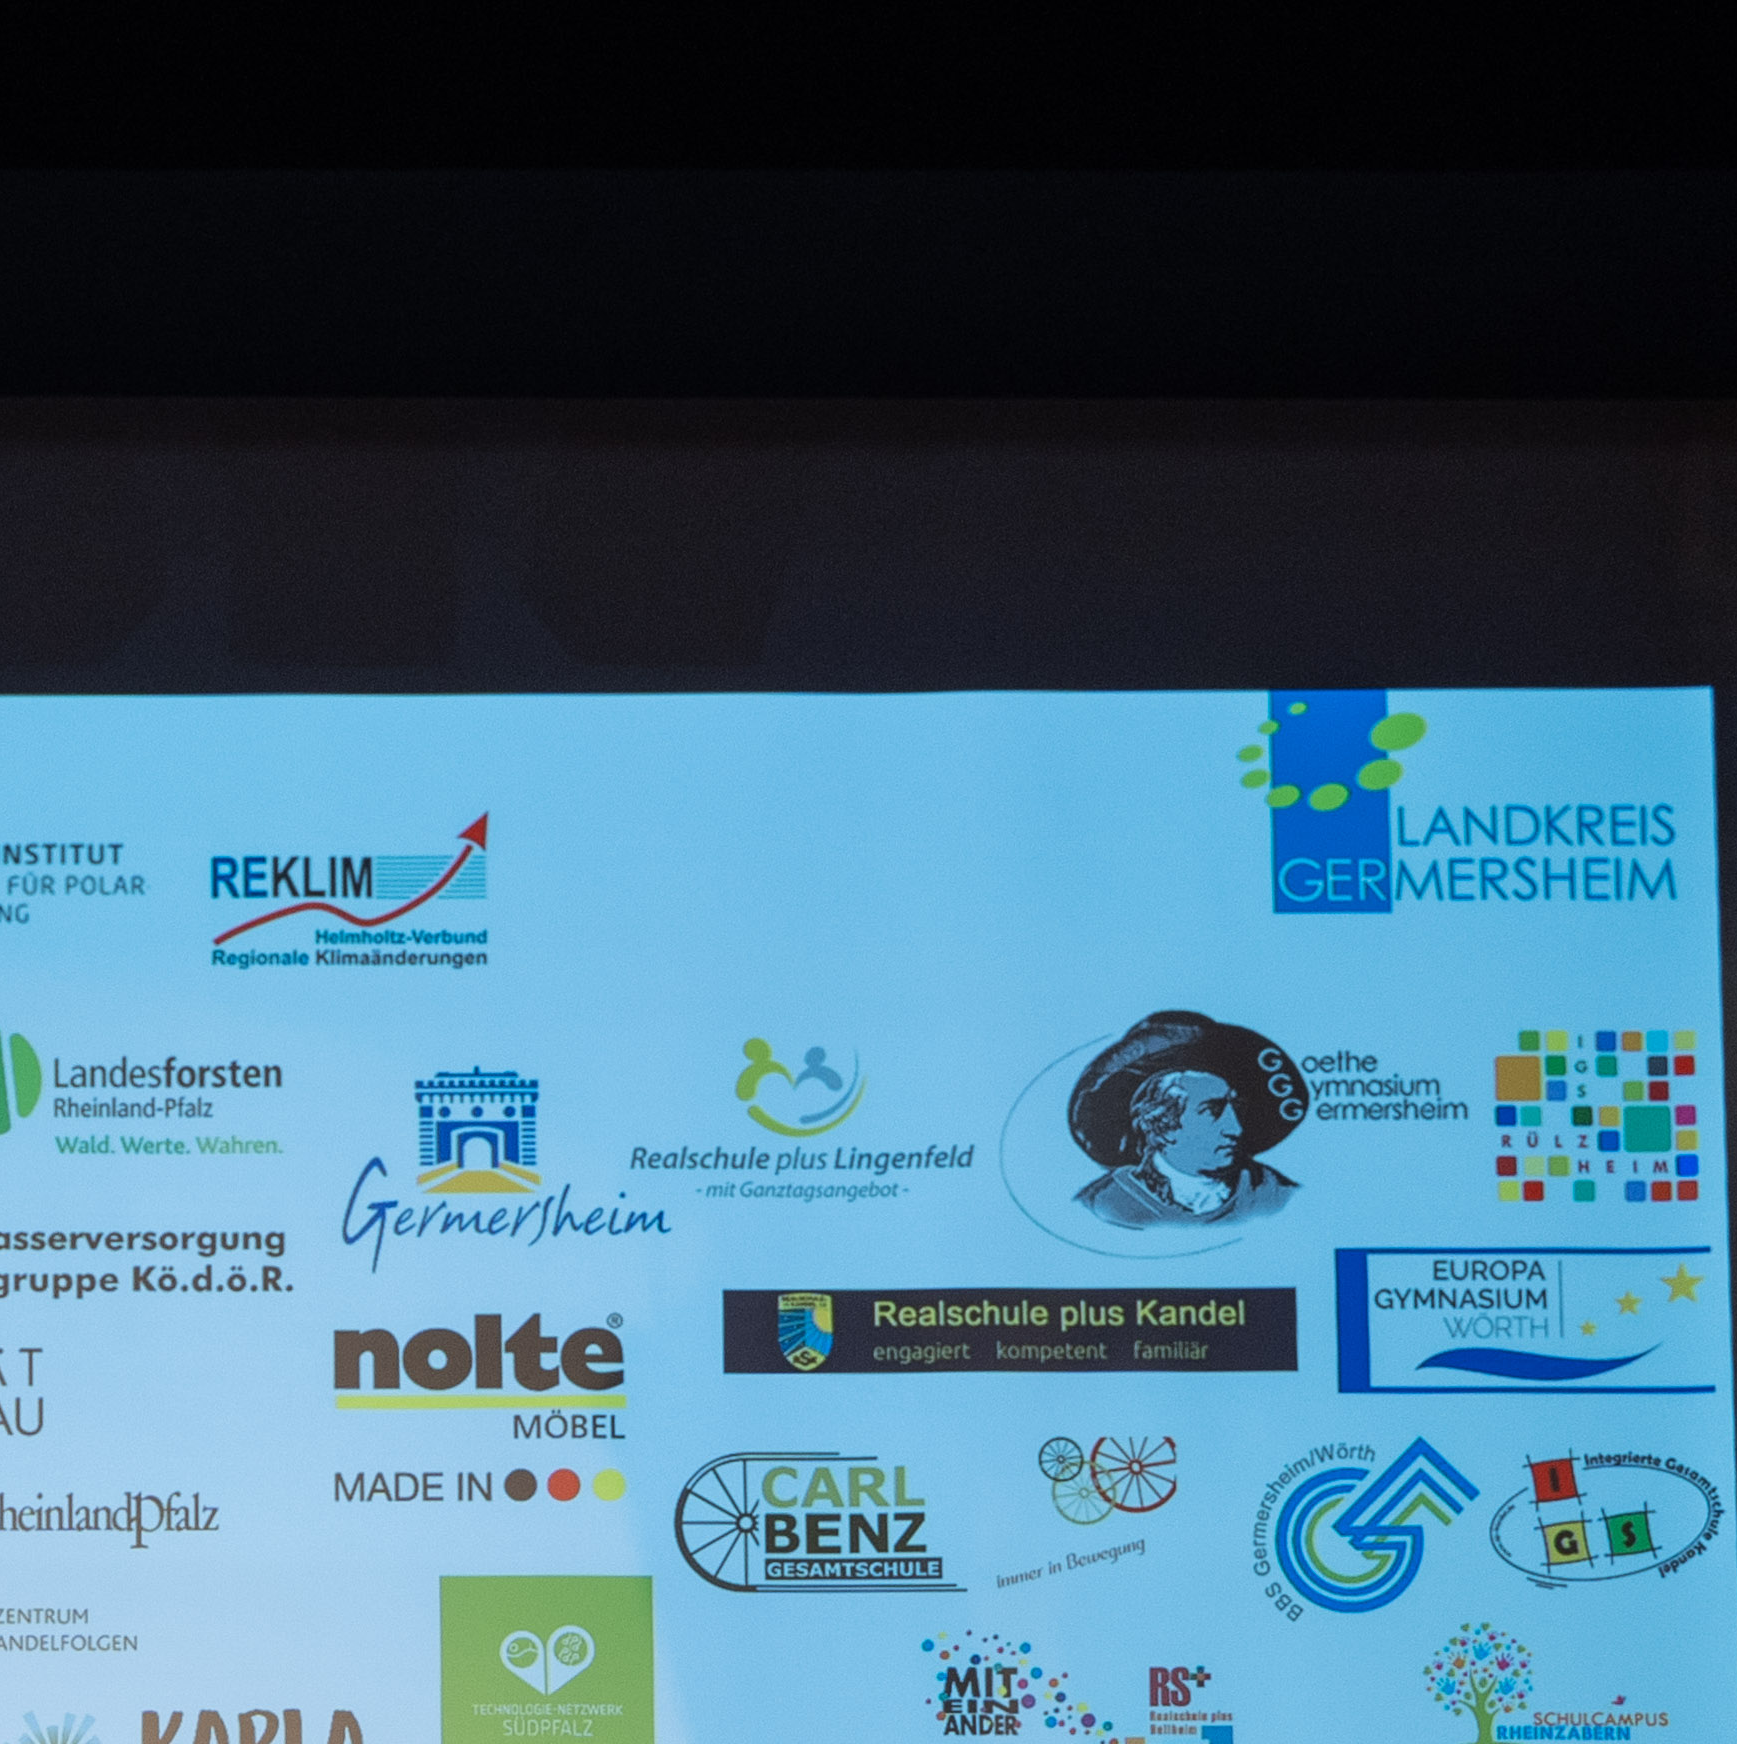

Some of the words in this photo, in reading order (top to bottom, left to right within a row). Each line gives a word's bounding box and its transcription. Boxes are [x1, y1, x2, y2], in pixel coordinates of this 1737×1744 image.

[1396, 803, 1677, 848] LANDKREIS
[7, 872, 58, 897] FÜR
[211, 855, 374, 899] REKLIM
[1277, 857, 1678, 902] GERMERSHEIM
[315, 928, 489, 947] Helmholtz-Verbund
[211, 949, 310, 969] Regionale
[315, 949, 489, 969] Klimaänderungen
[54, 1056, 283, 1090] Landesforsten
[1257, 1047, 1378, 1073] Goethe
[53, 1097, 214, 1122] Rheinland-Pfalz
[1279, 1097, 1469, 1122] Germersheim
[55, 1133, 117, 1156] Wald.
[121, 1133, 192, 1156] Werte.
[197, 1133, 284, 1156] Wahren.
[630, 1145, 771, 1172] Realschule
[775, 1146, 828, 1176] plus
[833, 1143, 975, 1176] Lingenfeld
[341, 1155, 672, 1274] Germersheim
[131, 1264, 295, 1295] Kö.d.ö.R.
[1433, 1260, 1546, 1281] EUROPA
[1374, 1288, 1548, 1310] GYMNASIUM
[873, 1299, 1048, 1328] Realschule
[1060, 1299, 1125, 1332] plus
[1136, 1297, 1247, 1328] Kandel
[1443, 1312, 1549, 1339] WÖRTH
[873, 1341, 972, 1364] engagiert
[996, 1340, 1109, 1365] kompetent
[1132, 1338, 1210, 1361] familiär
[512, 1412, 626, 1440] MÖBEL
[1583, 1452, 1662, 1467] Integrierte
[334, 1472, 445, 1503] MADE
[456, 1472, 494, 1502] IN
[761, 1465, 926, 1508] CARL
[765, 1512, 927, 1555] BENZ
[1065, 1539, 1147, 1571] Bewegung
[765, 1561, 941, 1580] GESAMTSCHULE
[1264, 1582, 1304, 1622] BBS
[944, 1666, 1018, 1698] MIT
[472, 1703, 624, 1717] TECHNOLOGIE-NETZWERK
[943, 1698, 1020, 1714] EIN
[503, 1716, 595, 1738] SÜDPFALZ
[943, 1714, 1019, 1735] ANDER
[1533, 1711, 1670, 1728] SCHULCAMPUS
[1496, 1725, 1632, 1742] RHEINZABERN
